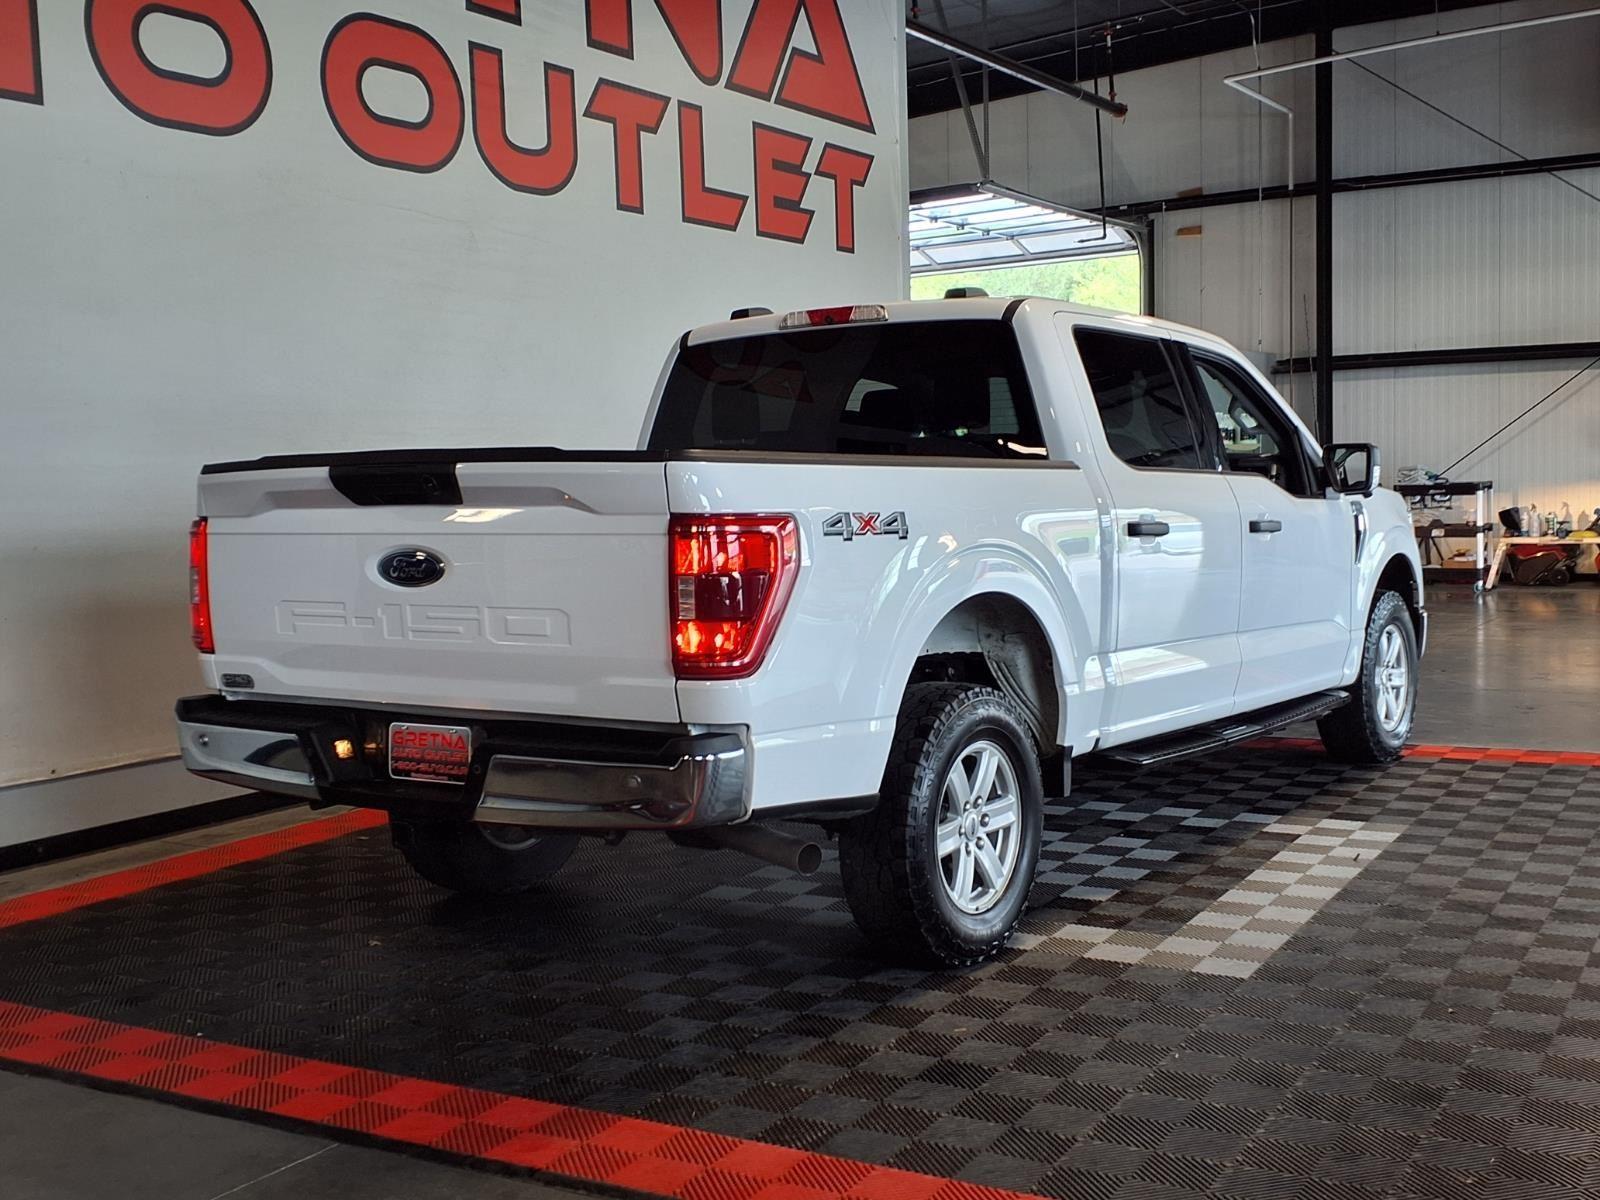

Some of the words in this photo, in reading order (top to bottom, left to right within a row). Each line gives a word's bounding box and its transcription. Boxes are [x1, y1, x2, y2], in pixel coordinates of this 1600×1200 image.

[320, 11, 875, 254] OUTLET
[389, 556, 428, 578] Ford
[274, 599, 572, 647] F-150
[392, 730, 466, 751] GRETNA
